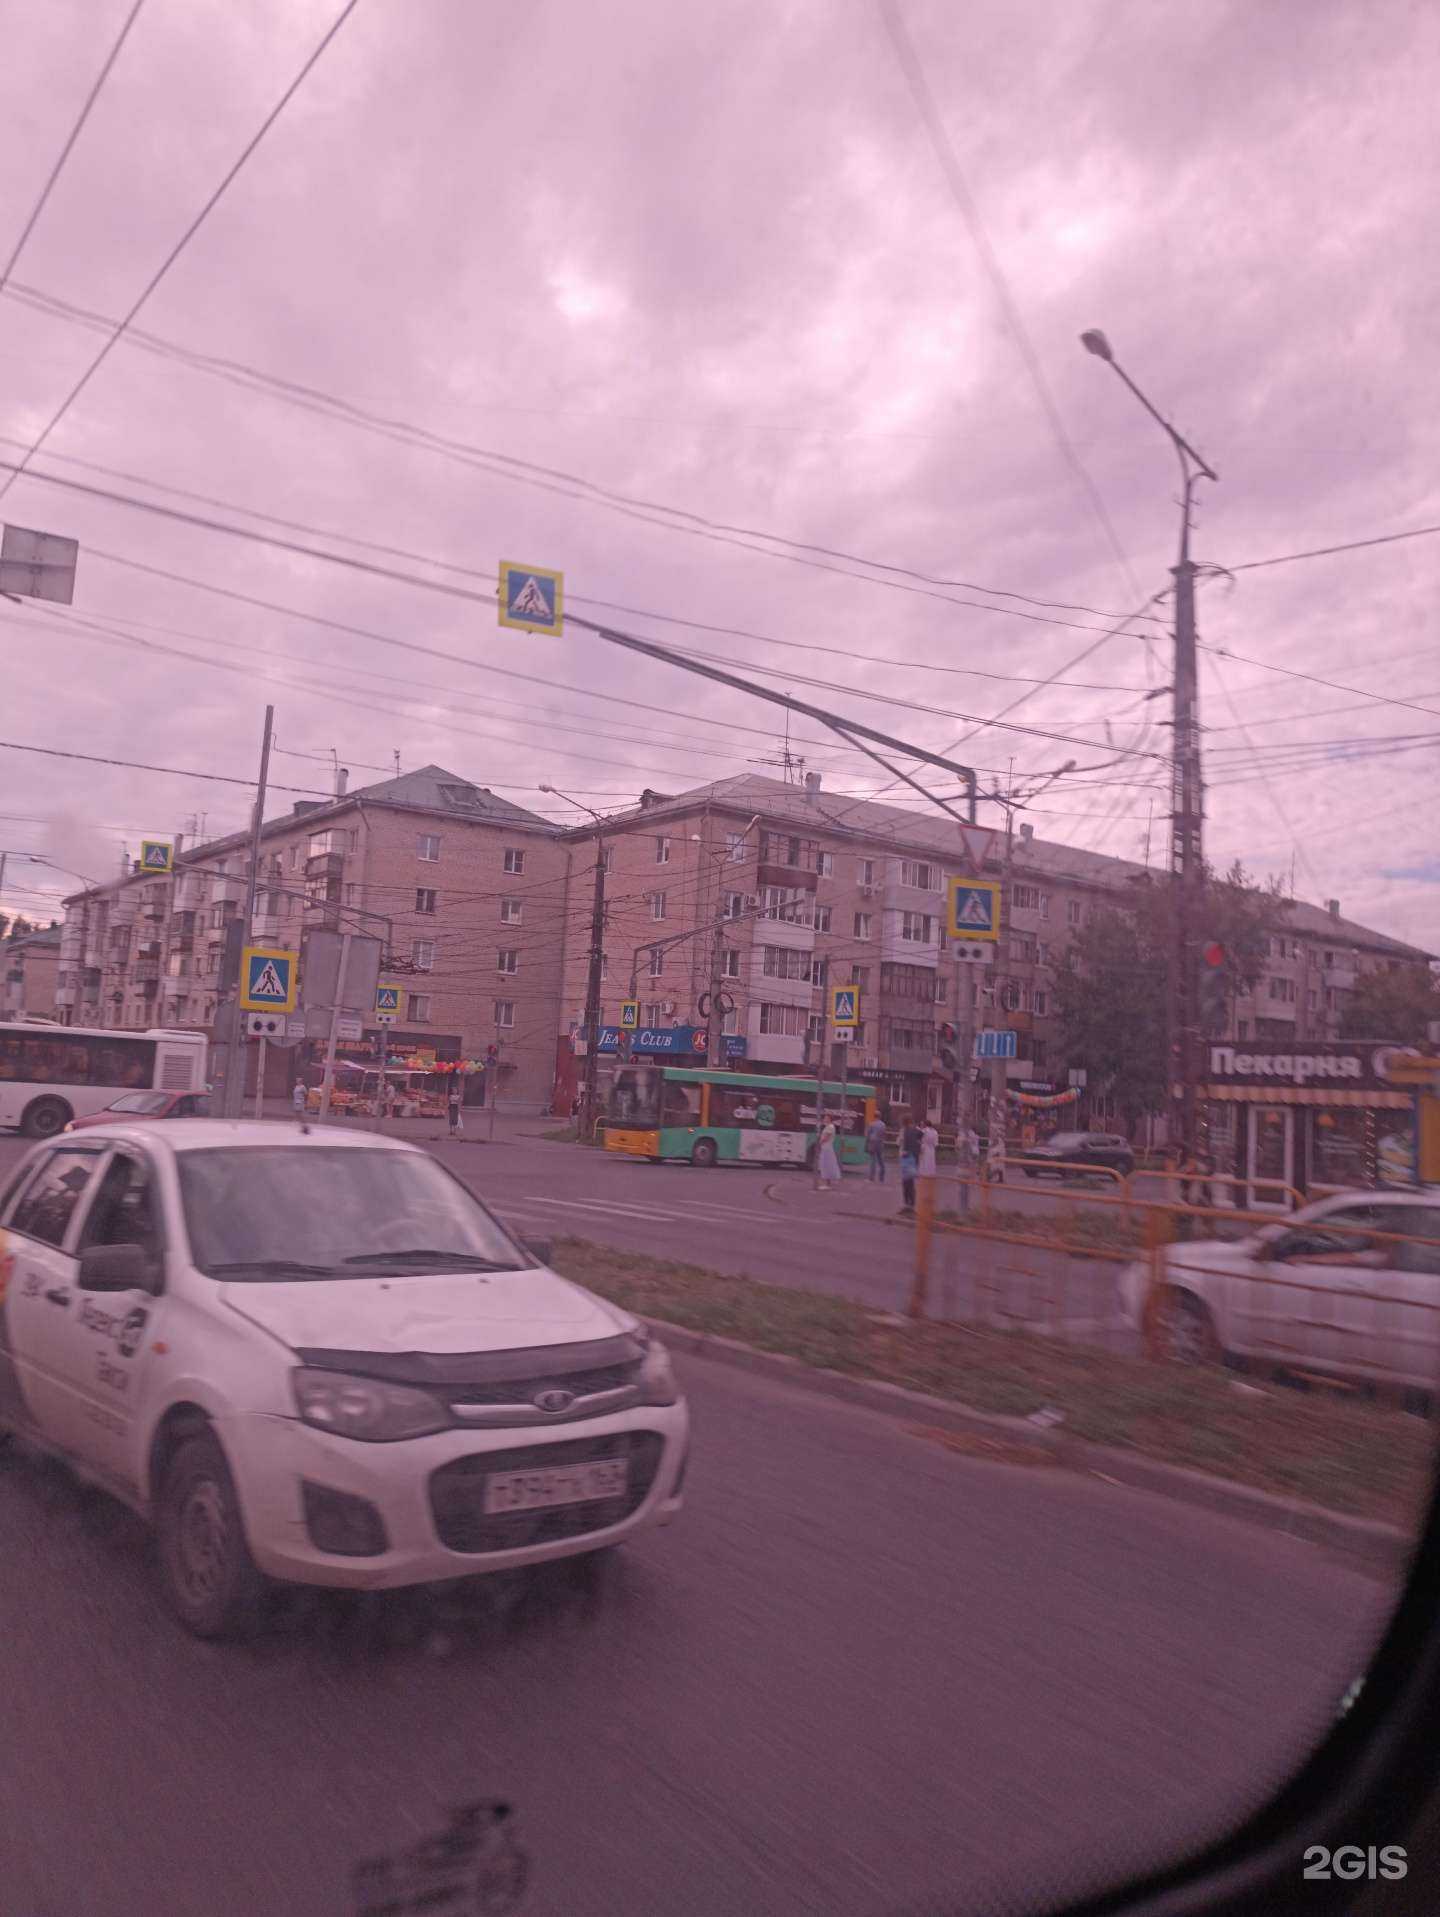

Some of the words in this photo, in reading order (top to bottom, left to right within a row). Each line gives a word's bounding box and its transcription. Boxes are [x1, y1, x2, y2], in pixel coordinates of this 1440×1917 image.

[597, 1029, 636, 1047] JEAS
[639, 1031, 673, 1047] CLUB
[1210, 1046, 1362, 1083] Пекарня
